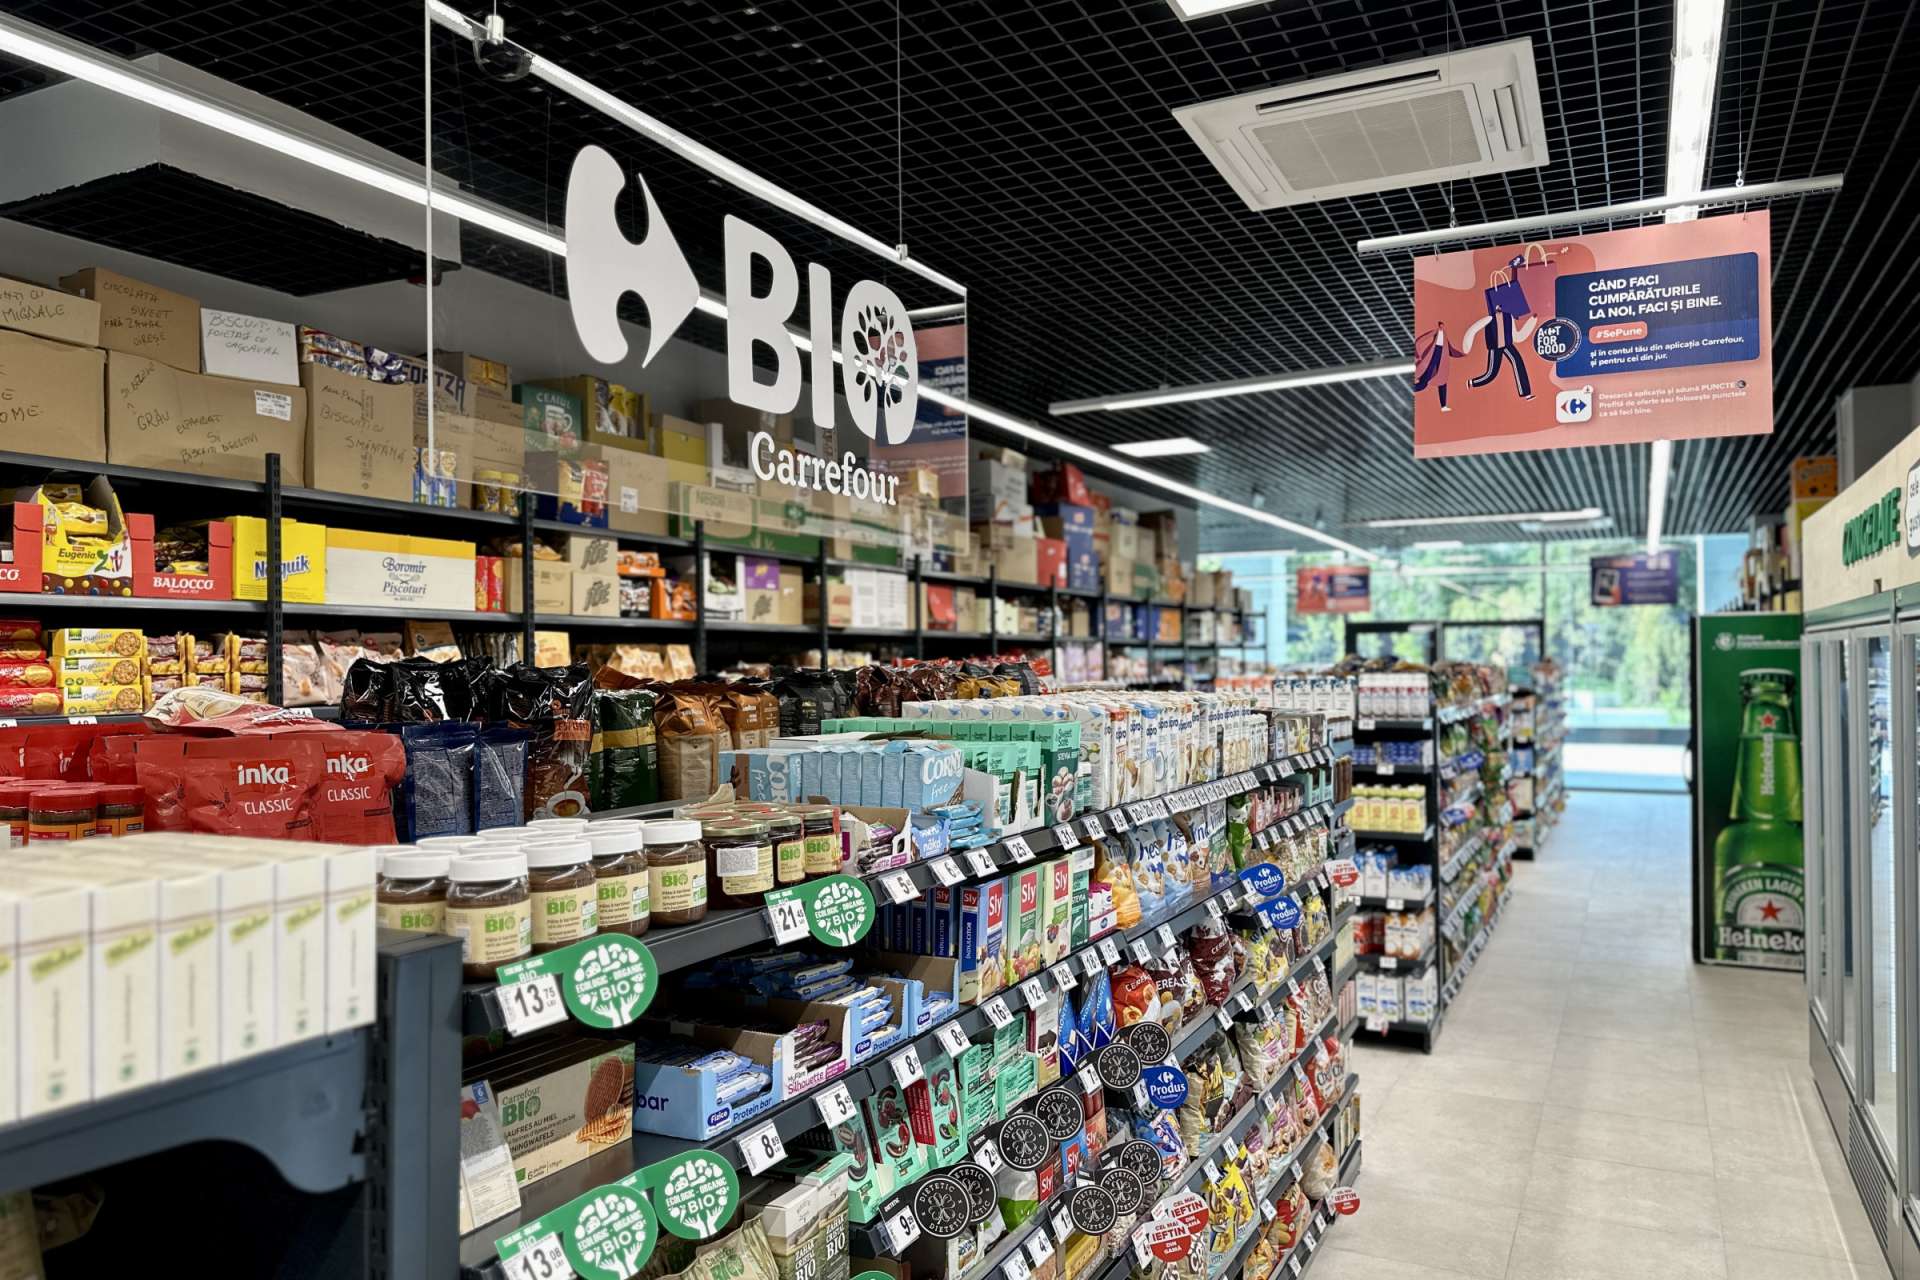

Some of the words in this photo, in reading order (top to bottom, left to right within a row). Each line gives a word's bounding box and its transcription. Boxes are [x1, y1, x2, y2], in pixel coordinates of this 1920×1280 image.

[1588, 279, 1627, 292] CÂND
[1630, 274, 1659, 288] FACI
[1588, 284, 1701, 306] CUMPĂRĂTURILE
[1588, 308, 1606, 320] LA
[1608, 305, 1636, 317] NOI,
[1638, 302, 1668, 314] FACI
[1670, 301, 1683, 314] ȘI
[1686, 296, 1722, 309] BINE.
[724, 213, 918, 445] BIO
[1596, 327, 1642, 340] #SePune
[1537, 336, 1557, 345] FOR
[1538, 344, 1566, 354] GOOD
[1608, 345, 1634, 356] contul
[1650, 342, 1663, 351] din
[1665, 338, 1700, 352] aplicația
[1598, 356, 1626, 366] pentru
[1626, 354, 1639, 363] cei
[1640, 353, 1654, 362] din
[1702, 382, 1735, 391] PUNCTE
[751, 431, 899, 506] Carrefour
[1842, 486, 1901, 567] CONGELATE
[58, 548, 97, 560] Eugenia
[382, 556, 428, 574] Boromir
[152, 576, 214, 591] BALOCCO
[382, 580, 426, 595] Pișcoturi
[327, 754, 368, 775] nka
[922, 752, 962, 786] CORNY
[237, 763, 290, 786] inka
[327, 786, 372, 804] CLASSIC
[244, 799, 294, 816] CLASSIC
[806, 840, 830, 854] BIO
[662, 874, 688, 888] BIO
[1055, 871, 1068, 892] Sly
[1254, 874, 1282, 890] Produs
[598, 885, 628, 900] BIO
[964, 892, 978, 904] Sly
[1022, 882, 1037, 905] Sly
[546, 900, 578, 916] BIO
[989, 895, 1002, 917] Sly
[1270, 906, 1298, 922] Produs
[400, 913, 434, 929] BIO
[485, 916, 516, 934] BIO
[778, 904, 798, 931] 21
[832, 911, 855, 926] BIO
[1719, 926, 1804, 952] Heinek
[600, 980, 630, 1001] BIO
[1028, 984, 1042, 1001] 12
[514, 984, 545, 1017] 13
[544, 987, 556, 999] 75
[951, 1029, 962, 1046] 8
[1134, 1027, 1160, 1039] DIETETIC
[906, 1055, 915, 1074] 8
[1102, 1048, 1129, 1064] DIETETIC
[788, 1072, 824, 1095] Silhouette
[1110, 1068, 1136, 1085] DIETETIC
[503, 1086, 541, 1104] Carrefour
[1150, 1082, 1186, 1097] Produs
[502, 1096, 542, 1126] BIO
[636, 1092, 670, 1112] bar
[710, 1110, 728, 1122] Fizico
[732, 1104, 756, 1123] Protein
[757, 1097, 772, 1114] bar
[834, 1094, 846, 1116] 5
[1040, 1094, 1070, 1112] DIETETIC
[506, 1124, 533, 1138] AUFRES
[534, 1120, 543, 1128] AU
[1004, 1120, 1035, 1138] DIETETIC
[1050, 1118, 1078, 1139] DIETETIC
[510, 1130, 554, 1153] NINGWAFELS
[762, 1134, 775, 1159] 8
[772, 1138, 780, 1146] 89
[1086, 1132, 1097, 1147] Sly
[984, 1148, 996, 1168] 2
[1014, 1146, 1045, 1164] DIETETIC
[1068, 1152, 1079, 1167] Sly
[1124, 1144, 1151, 1158] DIETETIC
[954, 1168, 984, 1180] ETETIC
[1105, 1170, 1134, 1184] DIETETIC
[699, 1176, 728, 1194] ORGANIC
[920, 1182, 956, 1202] DIETETIC
[1041, 1176, 1054, 1192] Sly
[688, 1194, 715, 1215] BIO
[1076, 1189, 1105, 1204] DIETETIC
[1171, 1202, 1202, 1218] IEFTIN
[900, 1216, 910, 1236] 9
[929, 1212, 966, 1232] DIETETIC
[1082, 1215, 1112, 1231] DIETETIC
[1166, 1222, 1178, 1230] MAI
[600, 1230, 632, 1256] BIO
[1152, 1228, 1186, 1242] IEFTIN
[826, 1232, 846, 1260] BIO
[522, 1248, 552, 1280] 13
[550, 1247, 562, 1260] 08
[711, 1255, 745, 1278] BIO
[796, 1258, 816, 1280] BIO
